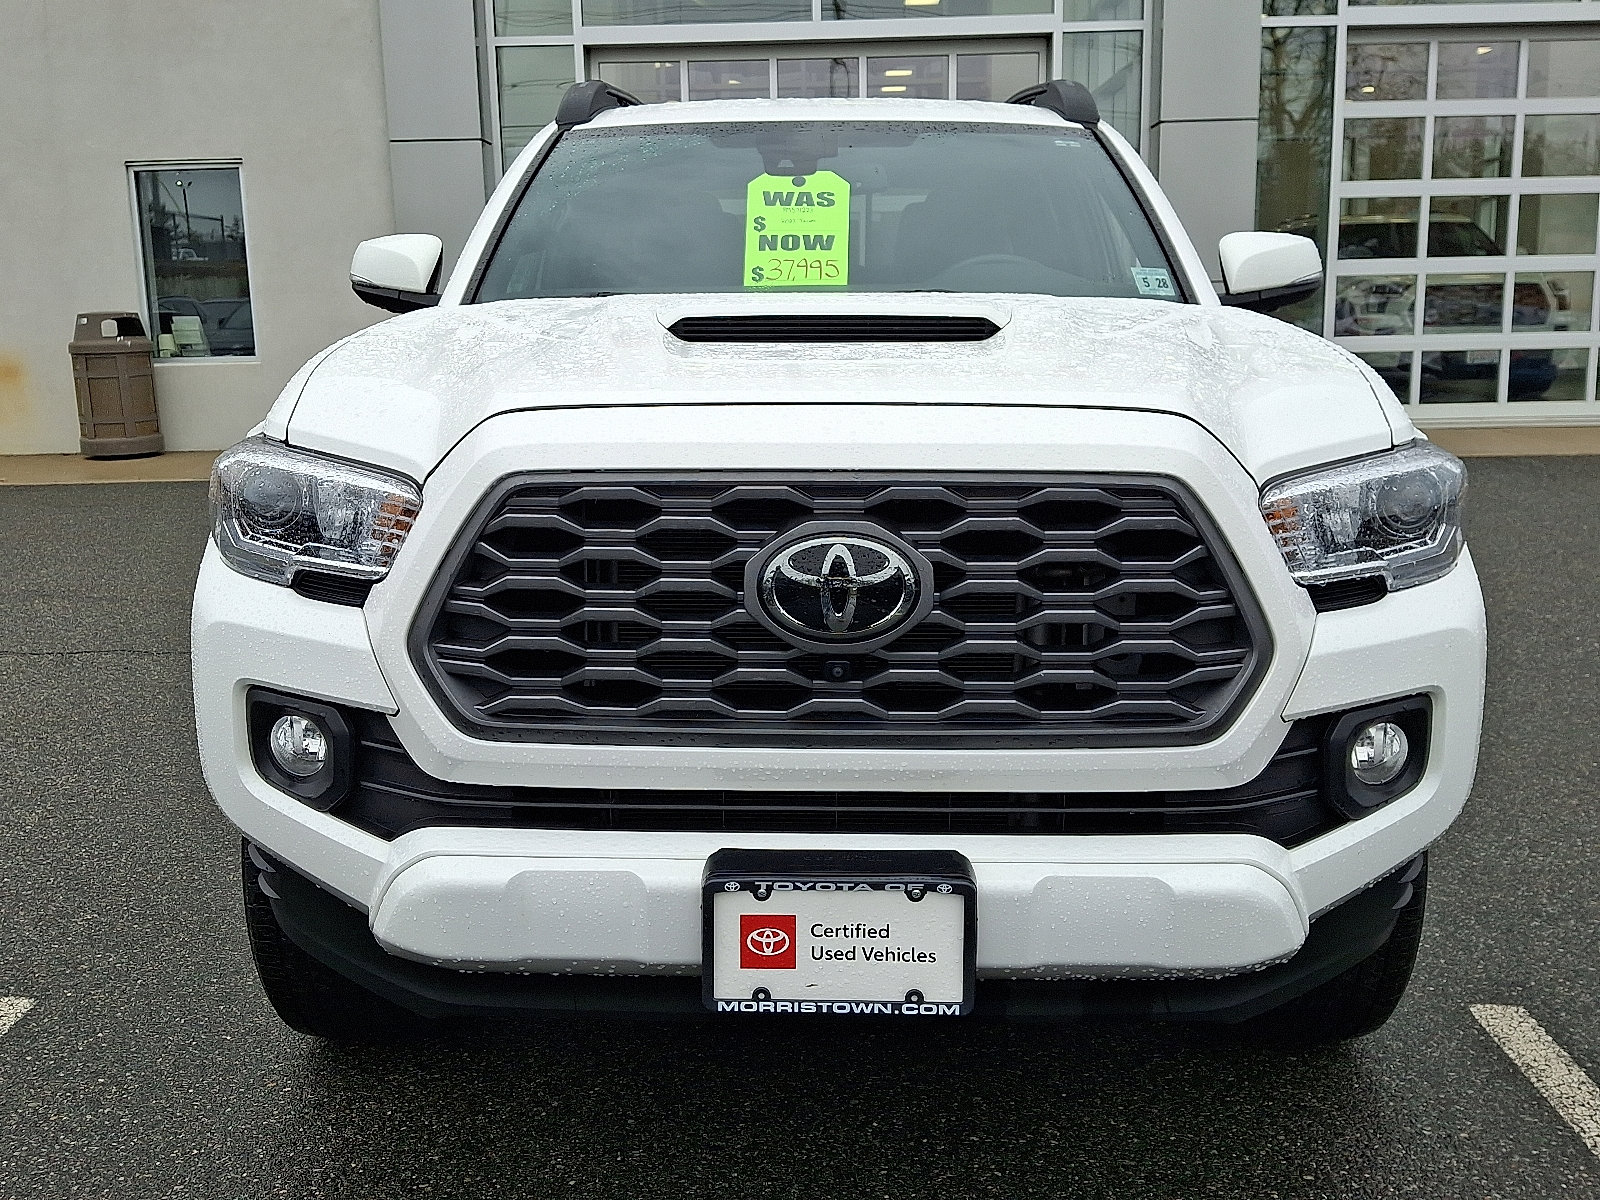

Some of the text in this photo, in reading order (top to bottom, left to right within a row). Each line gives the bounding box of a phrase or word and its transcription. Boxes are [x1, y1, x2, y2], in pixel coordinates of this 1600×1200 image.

[762, 190, 836, 208] WAS
[753, 215, 767, 233] $
[758, 234, 836, 252] NOW
[1142, 276, 1169, 289] 5 28
[754, 881, 925, 892] TOYOTA OF
[810, 922, 890, 939] Certified
[811, 945, 937, 964] Used Vehicles
[717, 1001, 961, 1016] MORRISTOWN.COM
